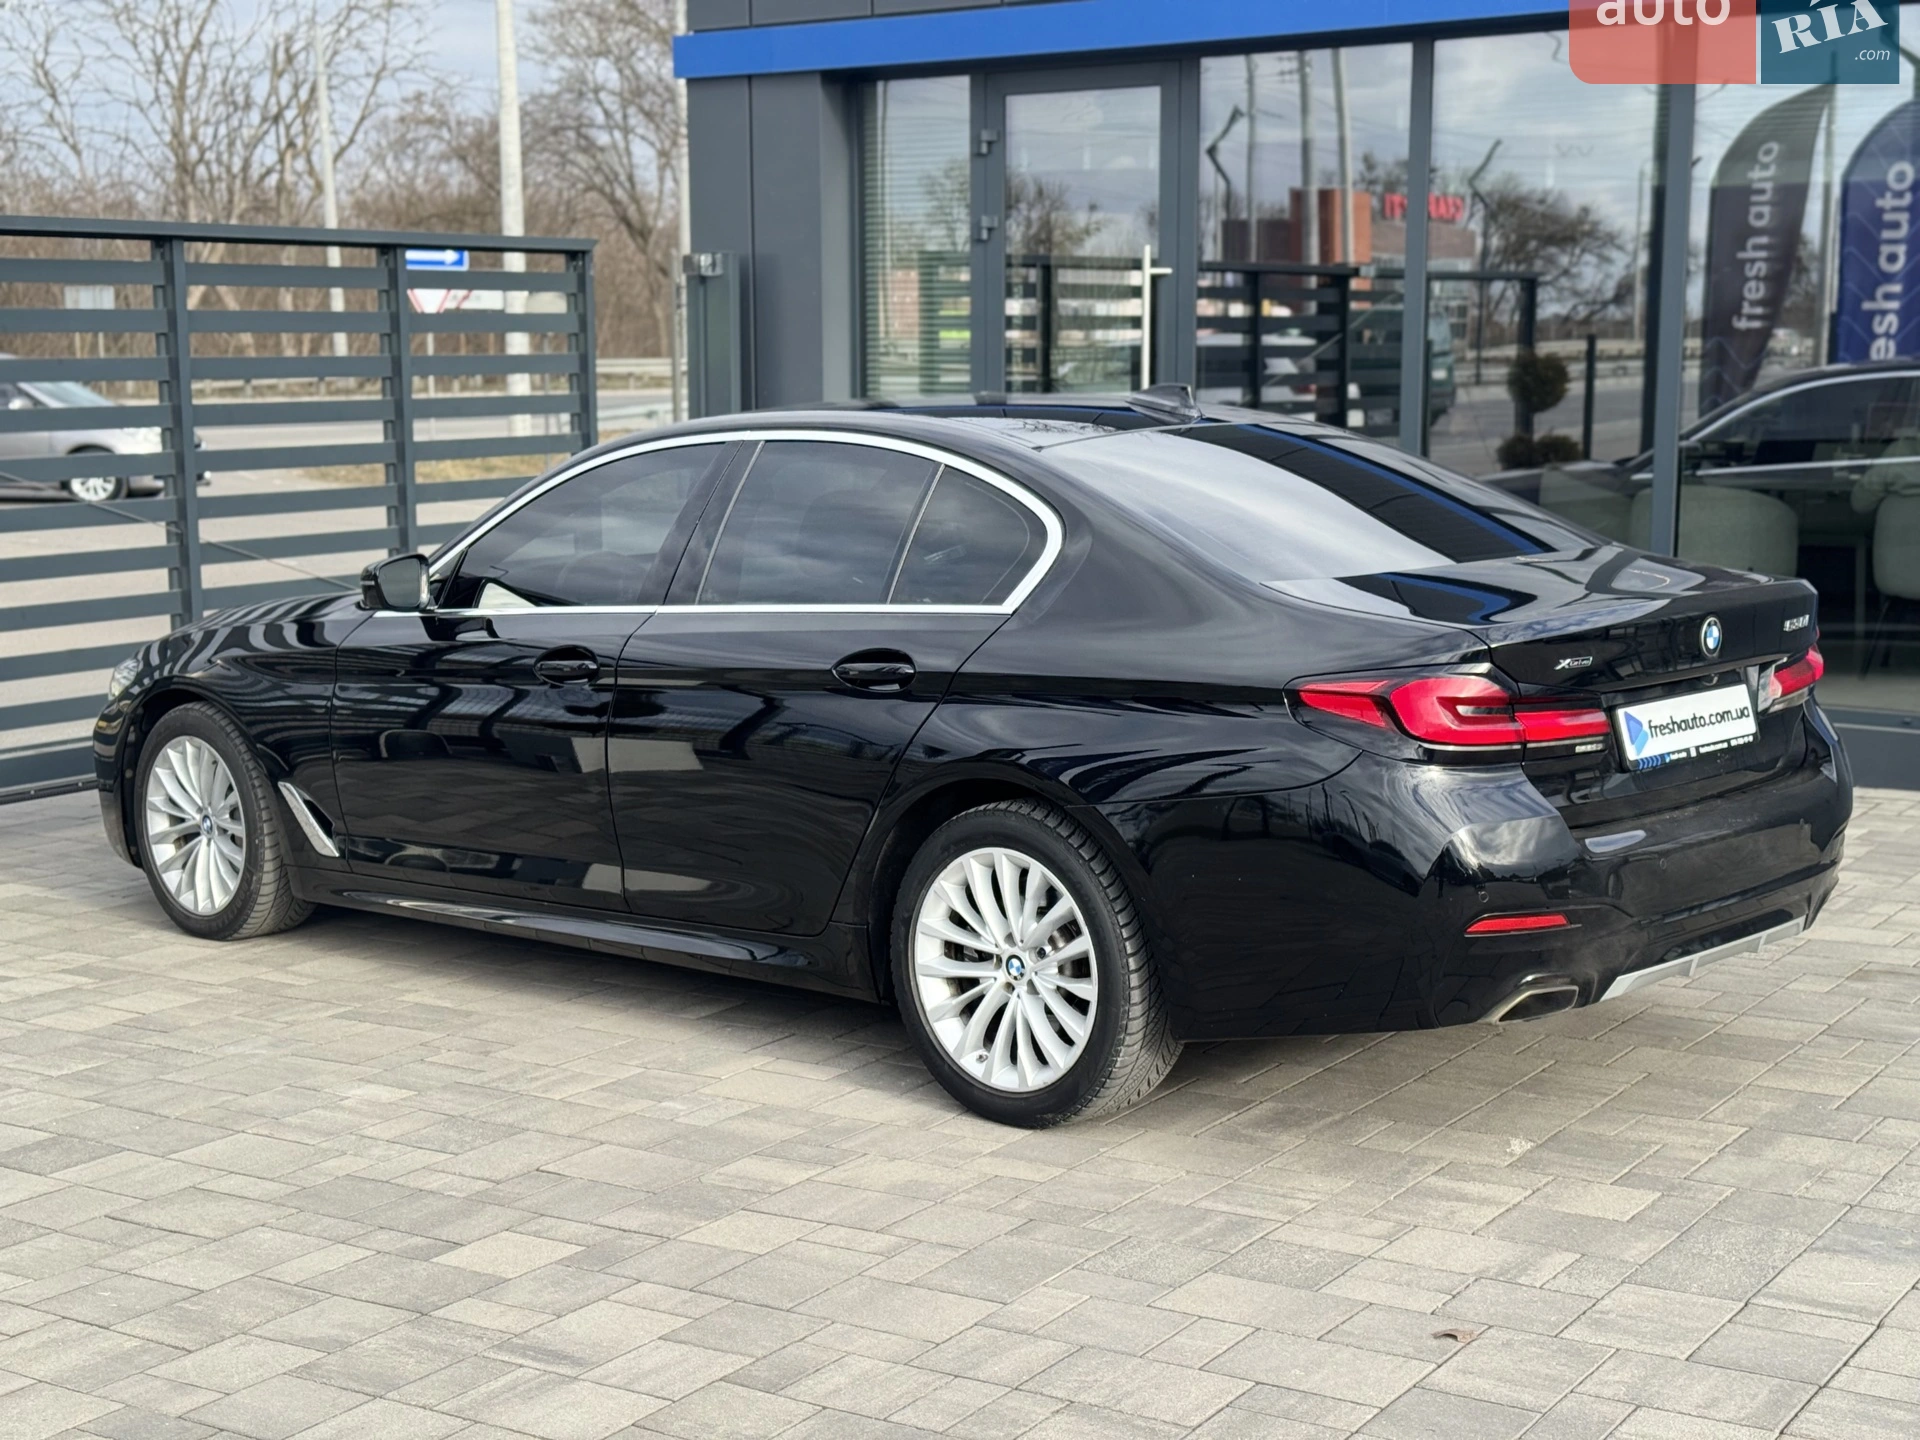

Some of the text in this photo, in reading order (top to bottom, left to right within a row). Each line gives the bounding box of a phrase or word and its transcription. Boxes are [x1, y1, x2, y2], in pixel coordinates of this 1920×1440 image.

[1732, 141, 1779, 331] fresh auto
[1875, 161, 1915, 273] auto
[1648, 706, 1750, 738] freshauto.com.ua
